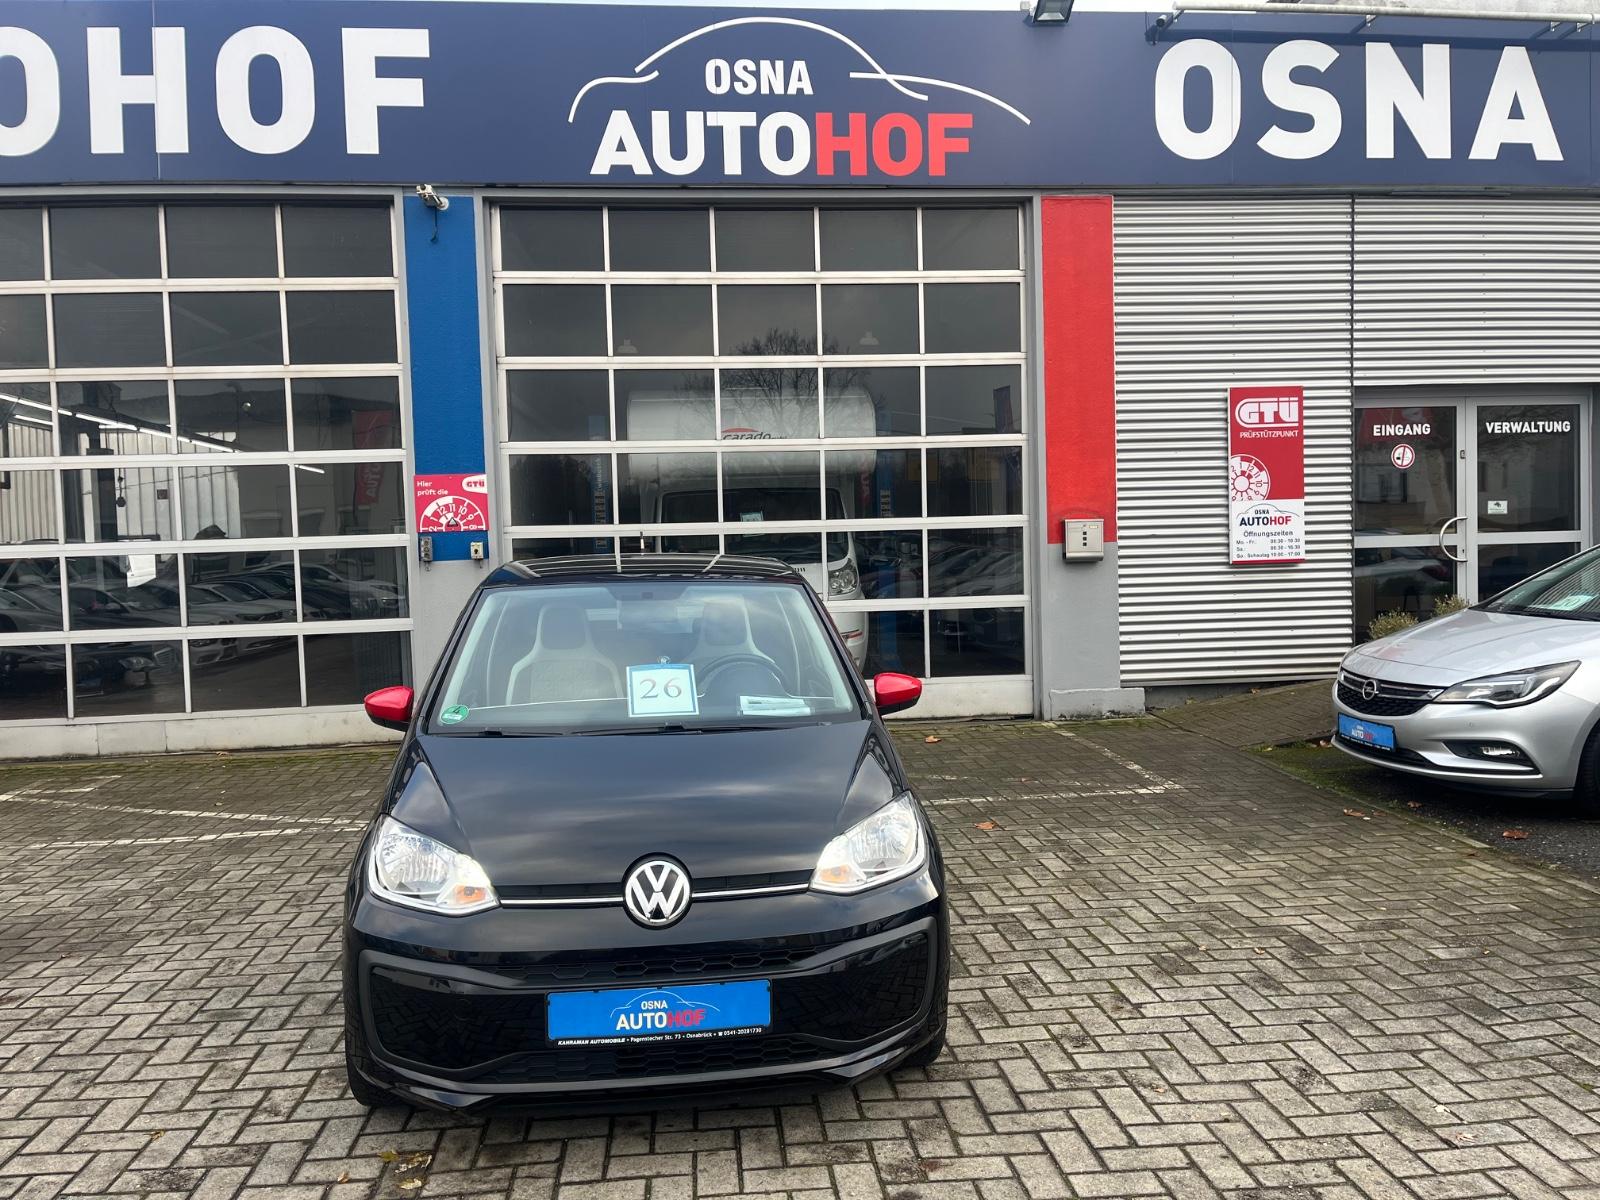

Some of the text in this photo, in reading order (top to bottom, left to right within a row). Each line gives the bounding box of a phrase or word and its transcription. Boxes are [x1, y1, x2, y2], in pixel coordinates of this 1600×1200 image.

[704, 58, 814, 95] OSNA
[0, 25, 430, 156] OHOF
[1154, 38, 1564, 161] OSNA
[590, 109, 974, 177] AUTOHOF
[1236, 397, 1299, 427] GTÜ
[1373, 423, 1431, 436] EINGANG
[1486, 420, 1571, 434] VERWALTUNG
[1239, 430, 1299, 438] PRÜFSTÜTZPUNKT
[1246, 463, 1255, 472] 12
[466, 479, 485, 487] GTÜ
[417, 488, 437, 496] prüft
[437, 506, 448, 516] 12
[449, 504, 455, 512] 11
[458, 505, 467, 515] 10
[1239, 515, 1292, 526] AUTOHOF
[640, 677, 682, 699] 26
[640, 1000, 668, 1010] OSNA
[616, 1009, 706, 1030] AUTOHOF
